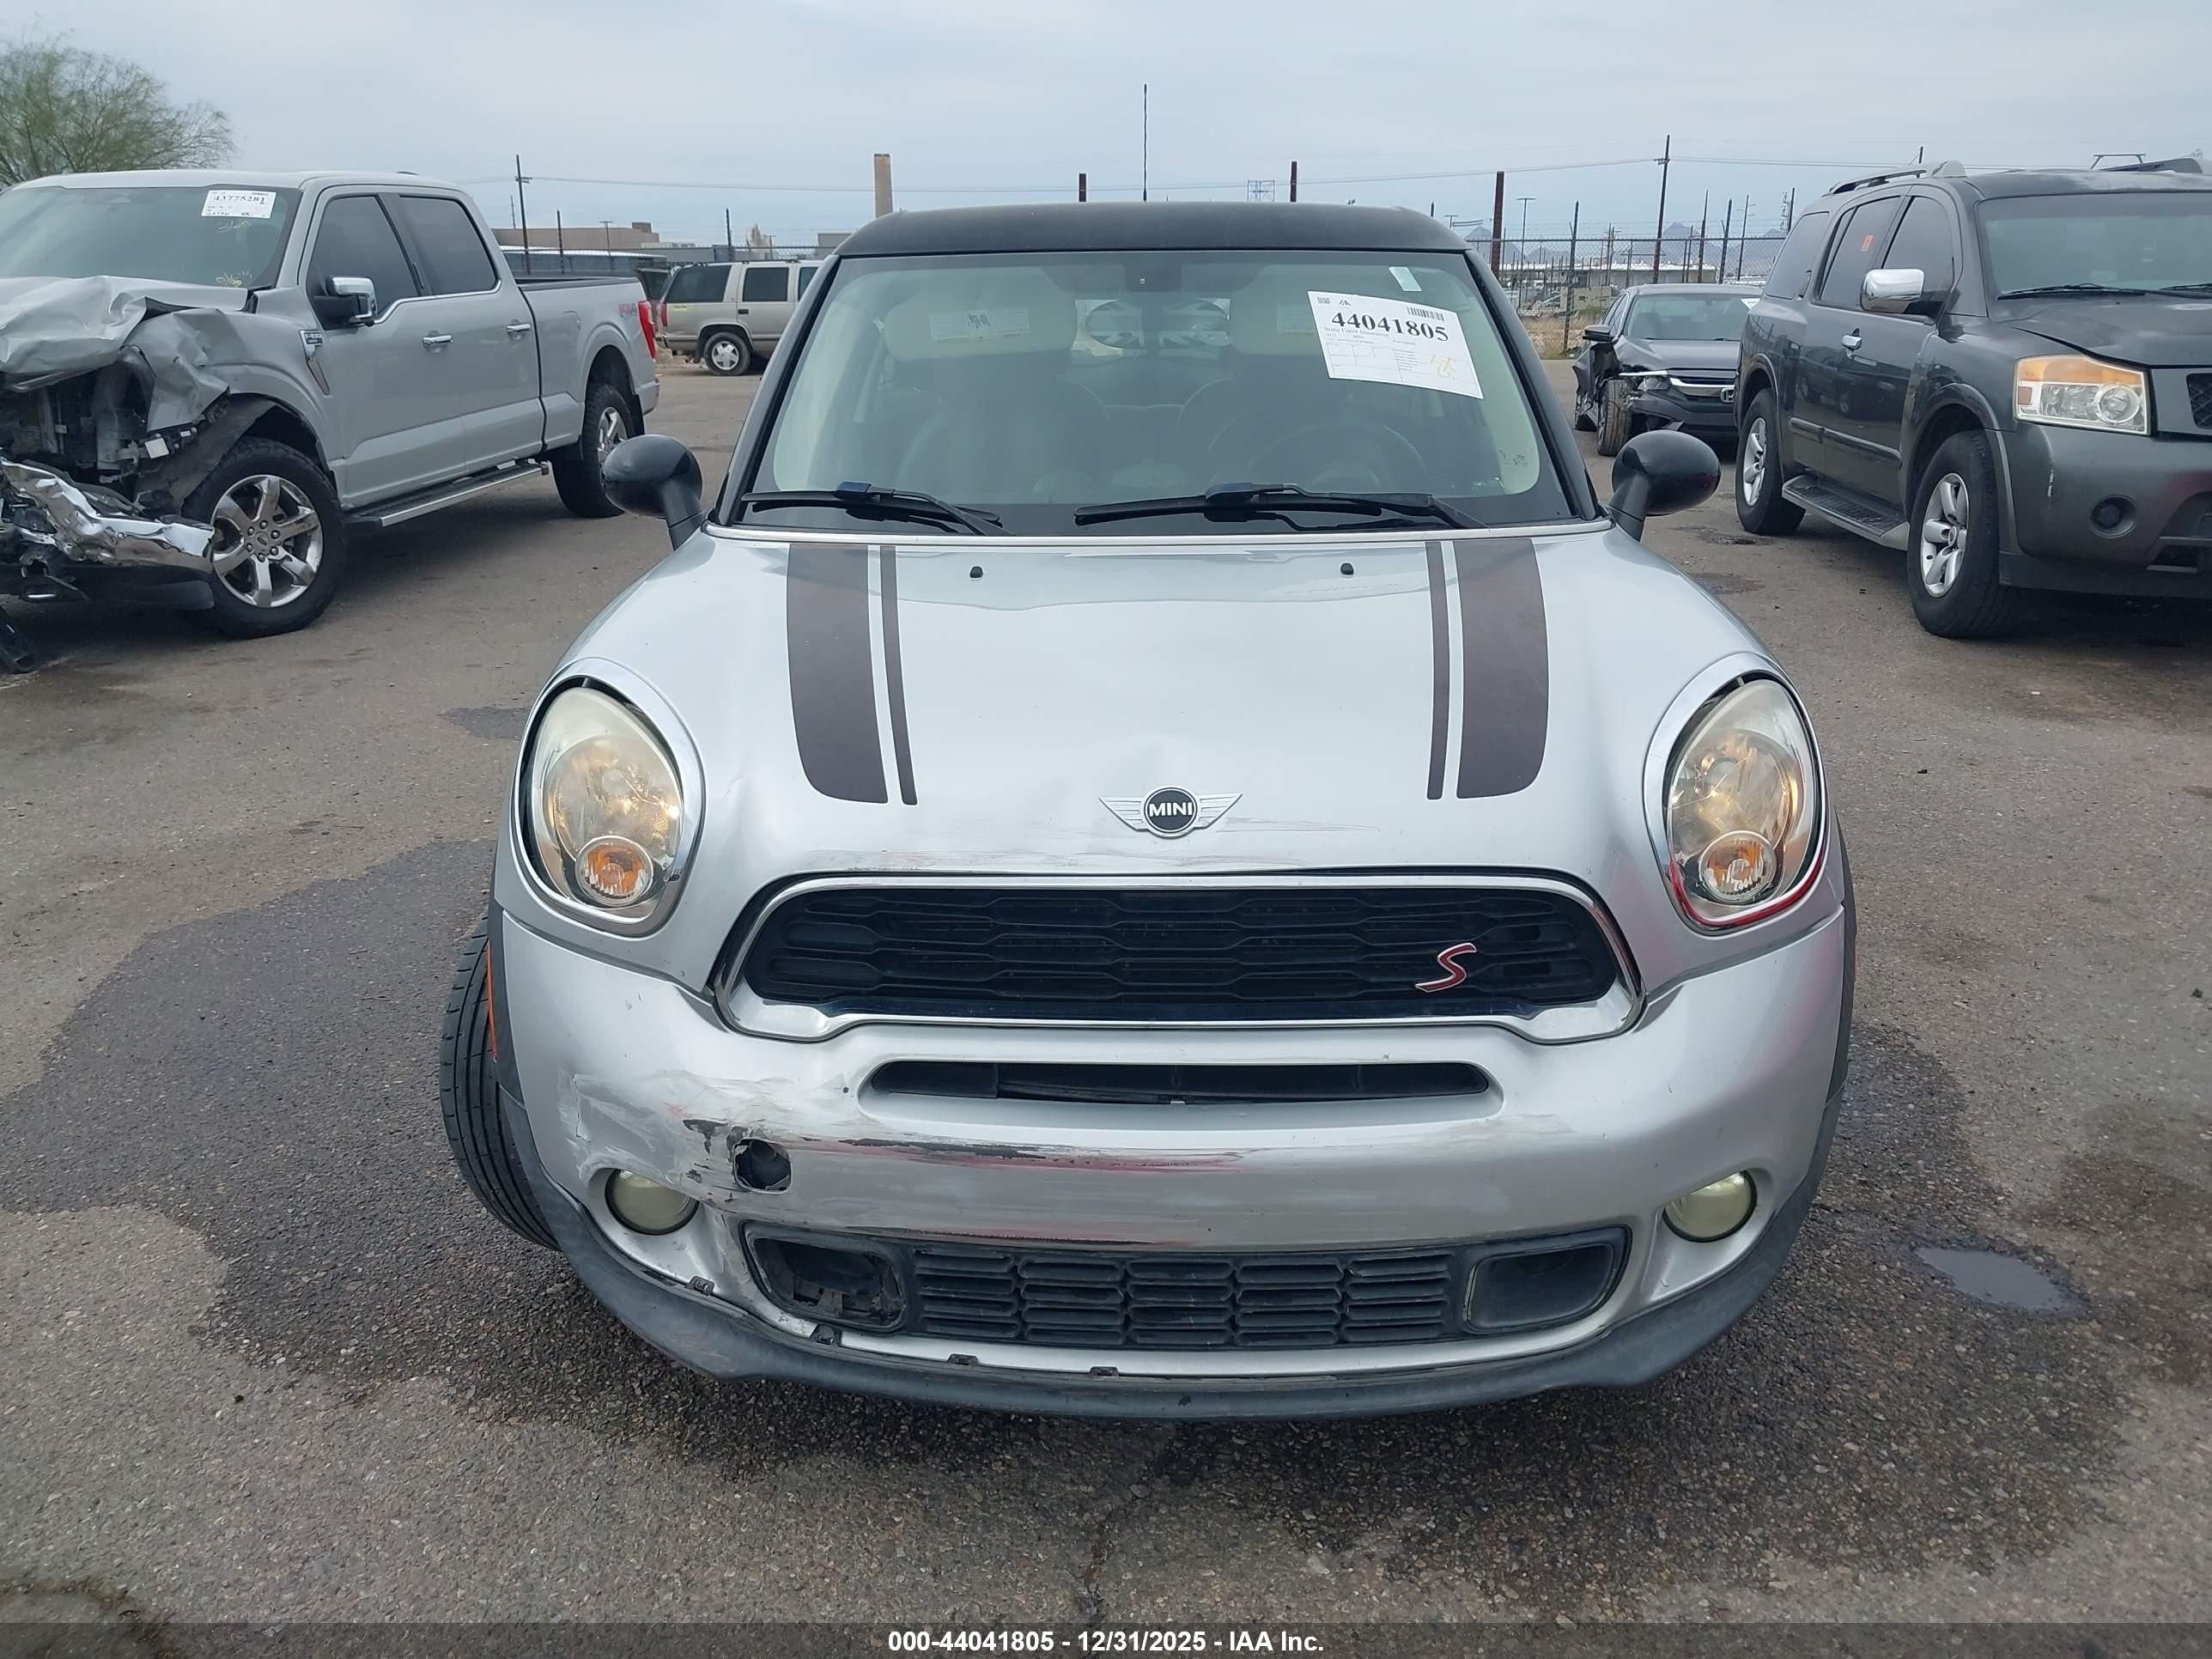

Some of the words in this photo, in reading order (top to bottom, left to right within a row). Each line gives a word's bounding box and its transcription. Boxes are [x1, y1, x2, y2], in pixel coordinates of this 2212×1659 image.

[1331, 312, 1449, 342] 44041805
[1149, 803, 1192, 817] MINI
[1415, 943, 1477, 993] S
